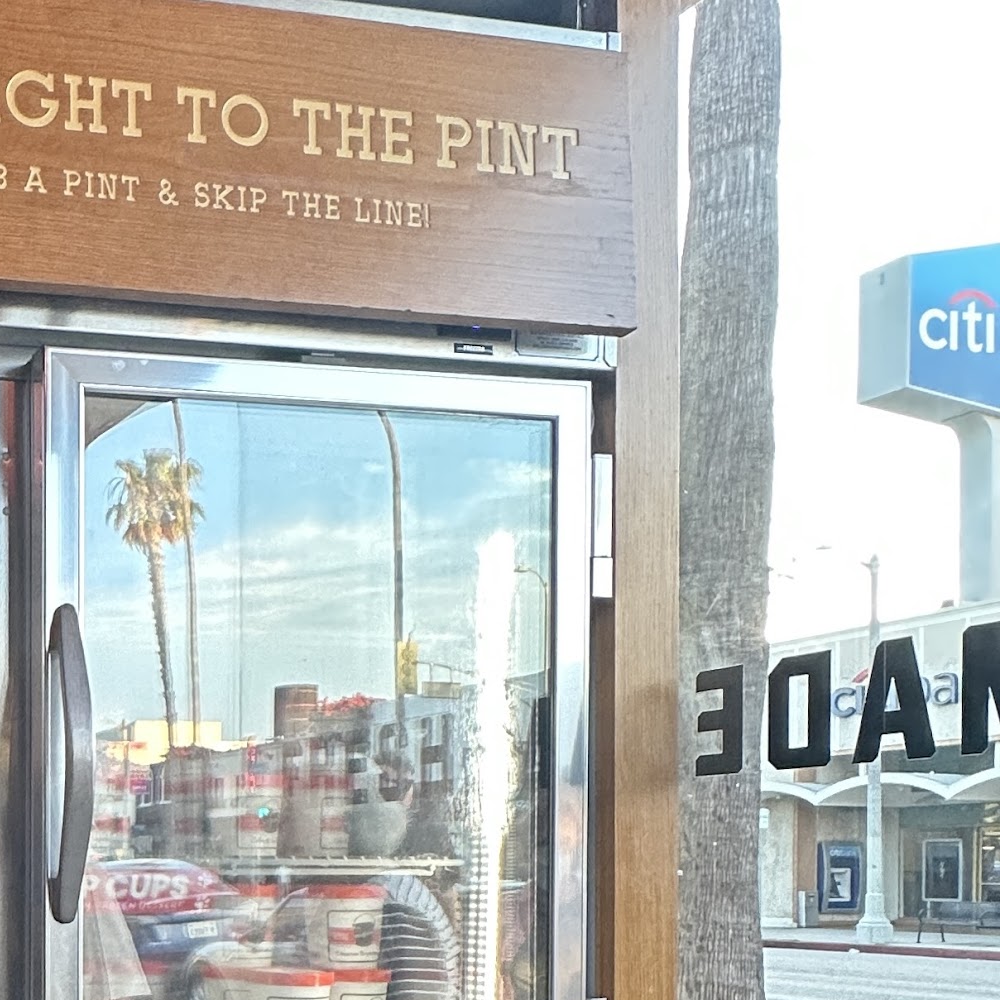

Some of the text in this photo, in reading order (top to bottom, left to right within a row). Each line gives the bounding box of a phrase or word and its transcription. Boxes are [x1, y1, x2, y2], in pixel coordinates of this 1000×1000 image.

[176, 85, 270, 148] TO
[292, 97, 415, 165] THE
[436, 113, 580, 180] PINT
[23, 165, 48, 195] A
[62, 168, 141, 203] PINT
[158, 178, 180, 207] &
[193, 181, 268, 214] SKIP
[281, 189, 341, 221] THE
[354, 196, 432, 229] LINE!
[918, 300, 996, 354] citi
[104, 872, 190, 900] CUPS
